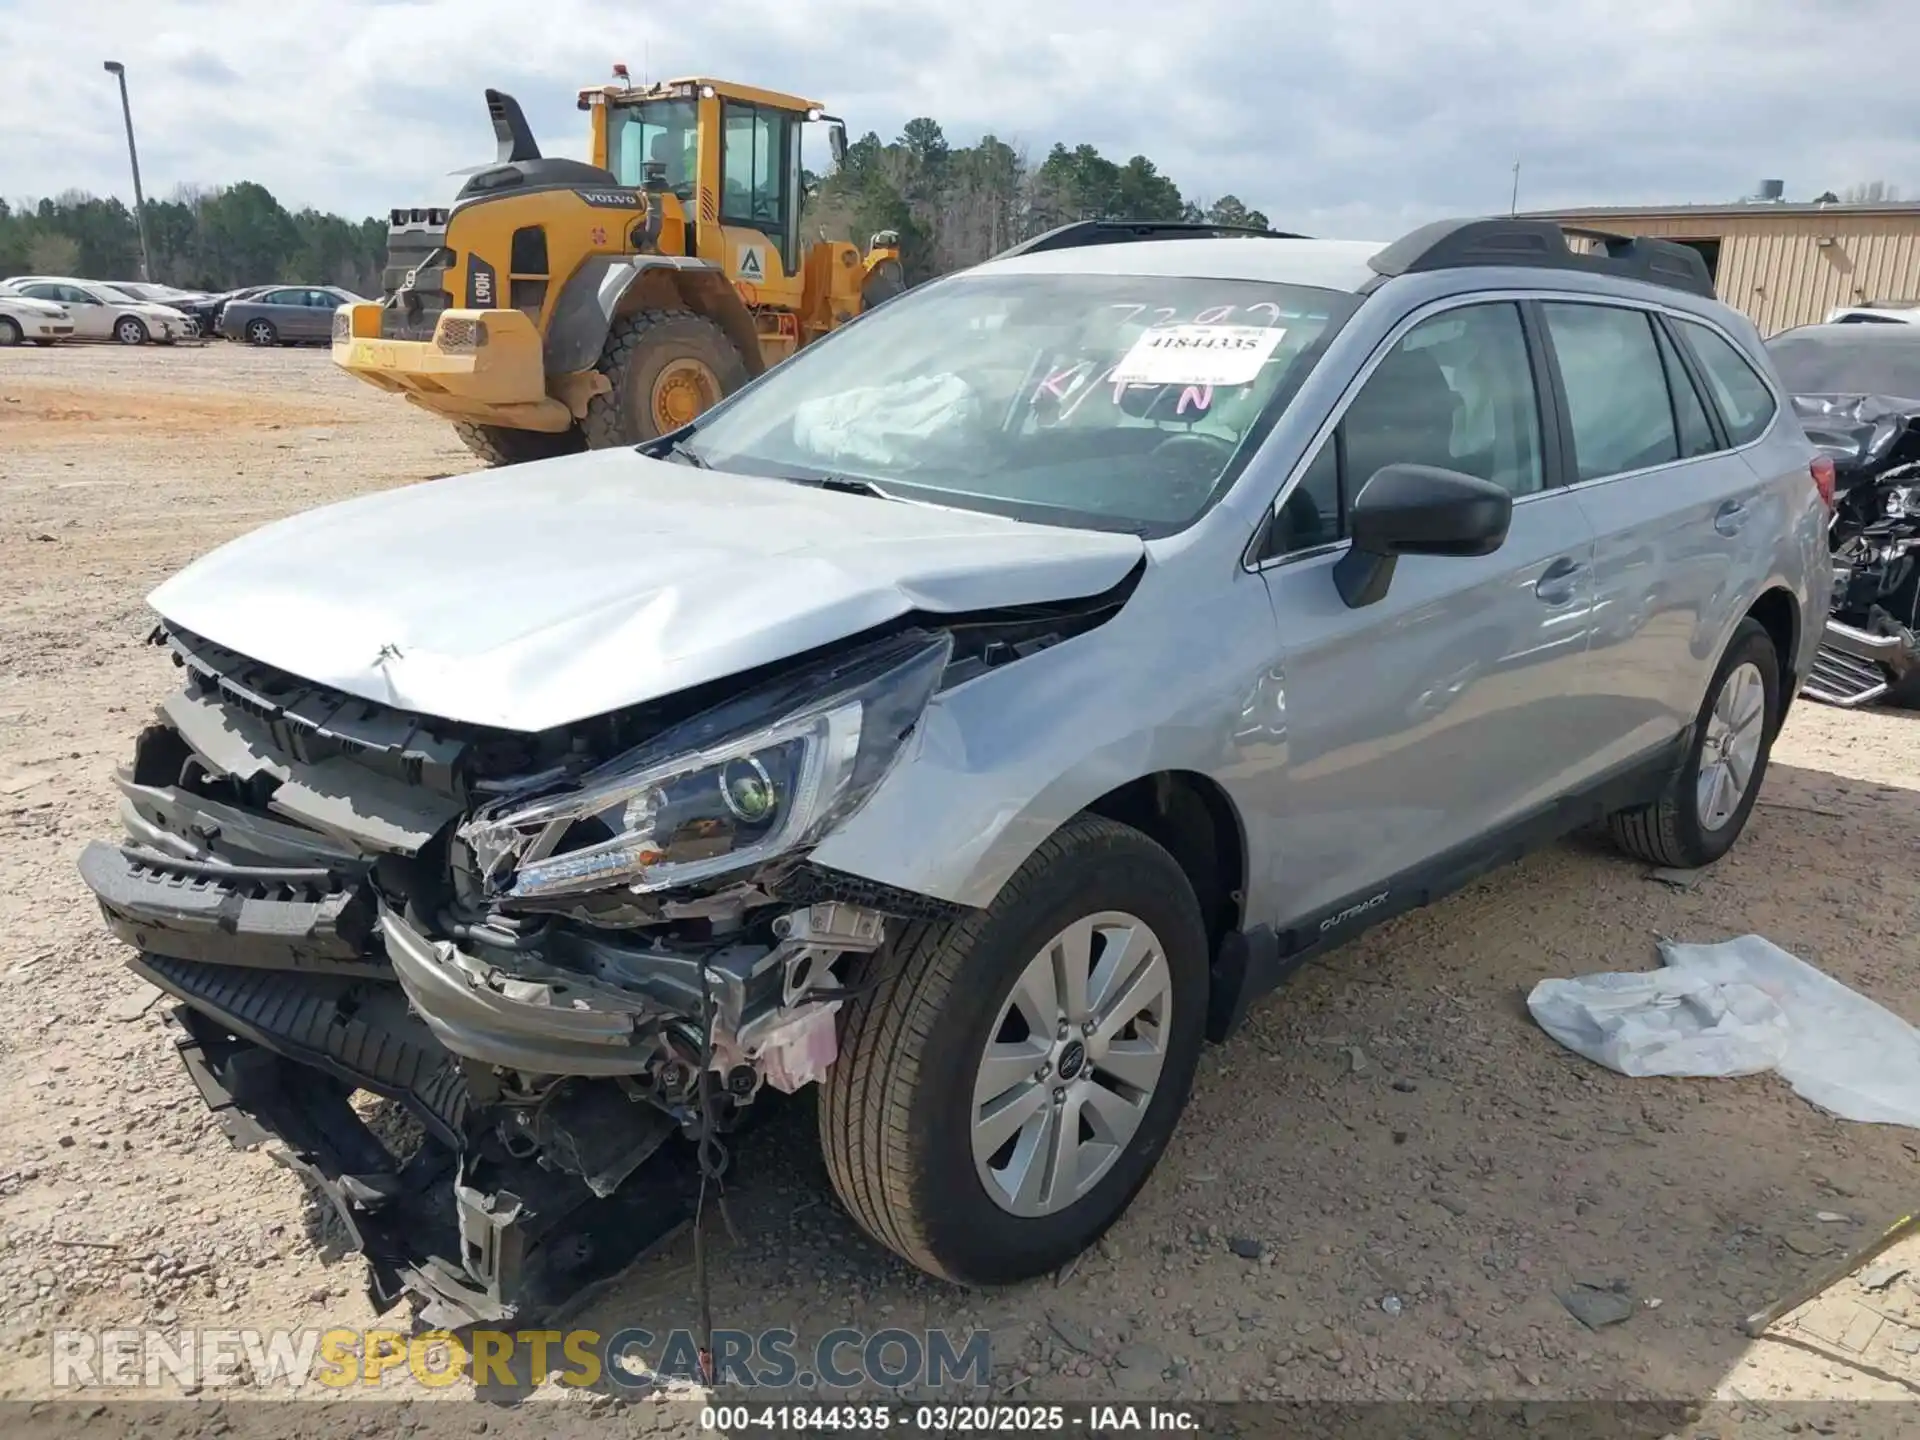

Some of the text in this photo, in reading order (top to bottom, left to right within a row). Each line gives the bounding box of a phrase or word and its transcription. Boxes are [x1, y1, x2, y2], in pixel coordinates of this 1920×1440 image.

[584, 193, 636, 205] VOLVO
[474, 272, 491, 303] L90H
[1148, 337, 1259, 350] 41844335
